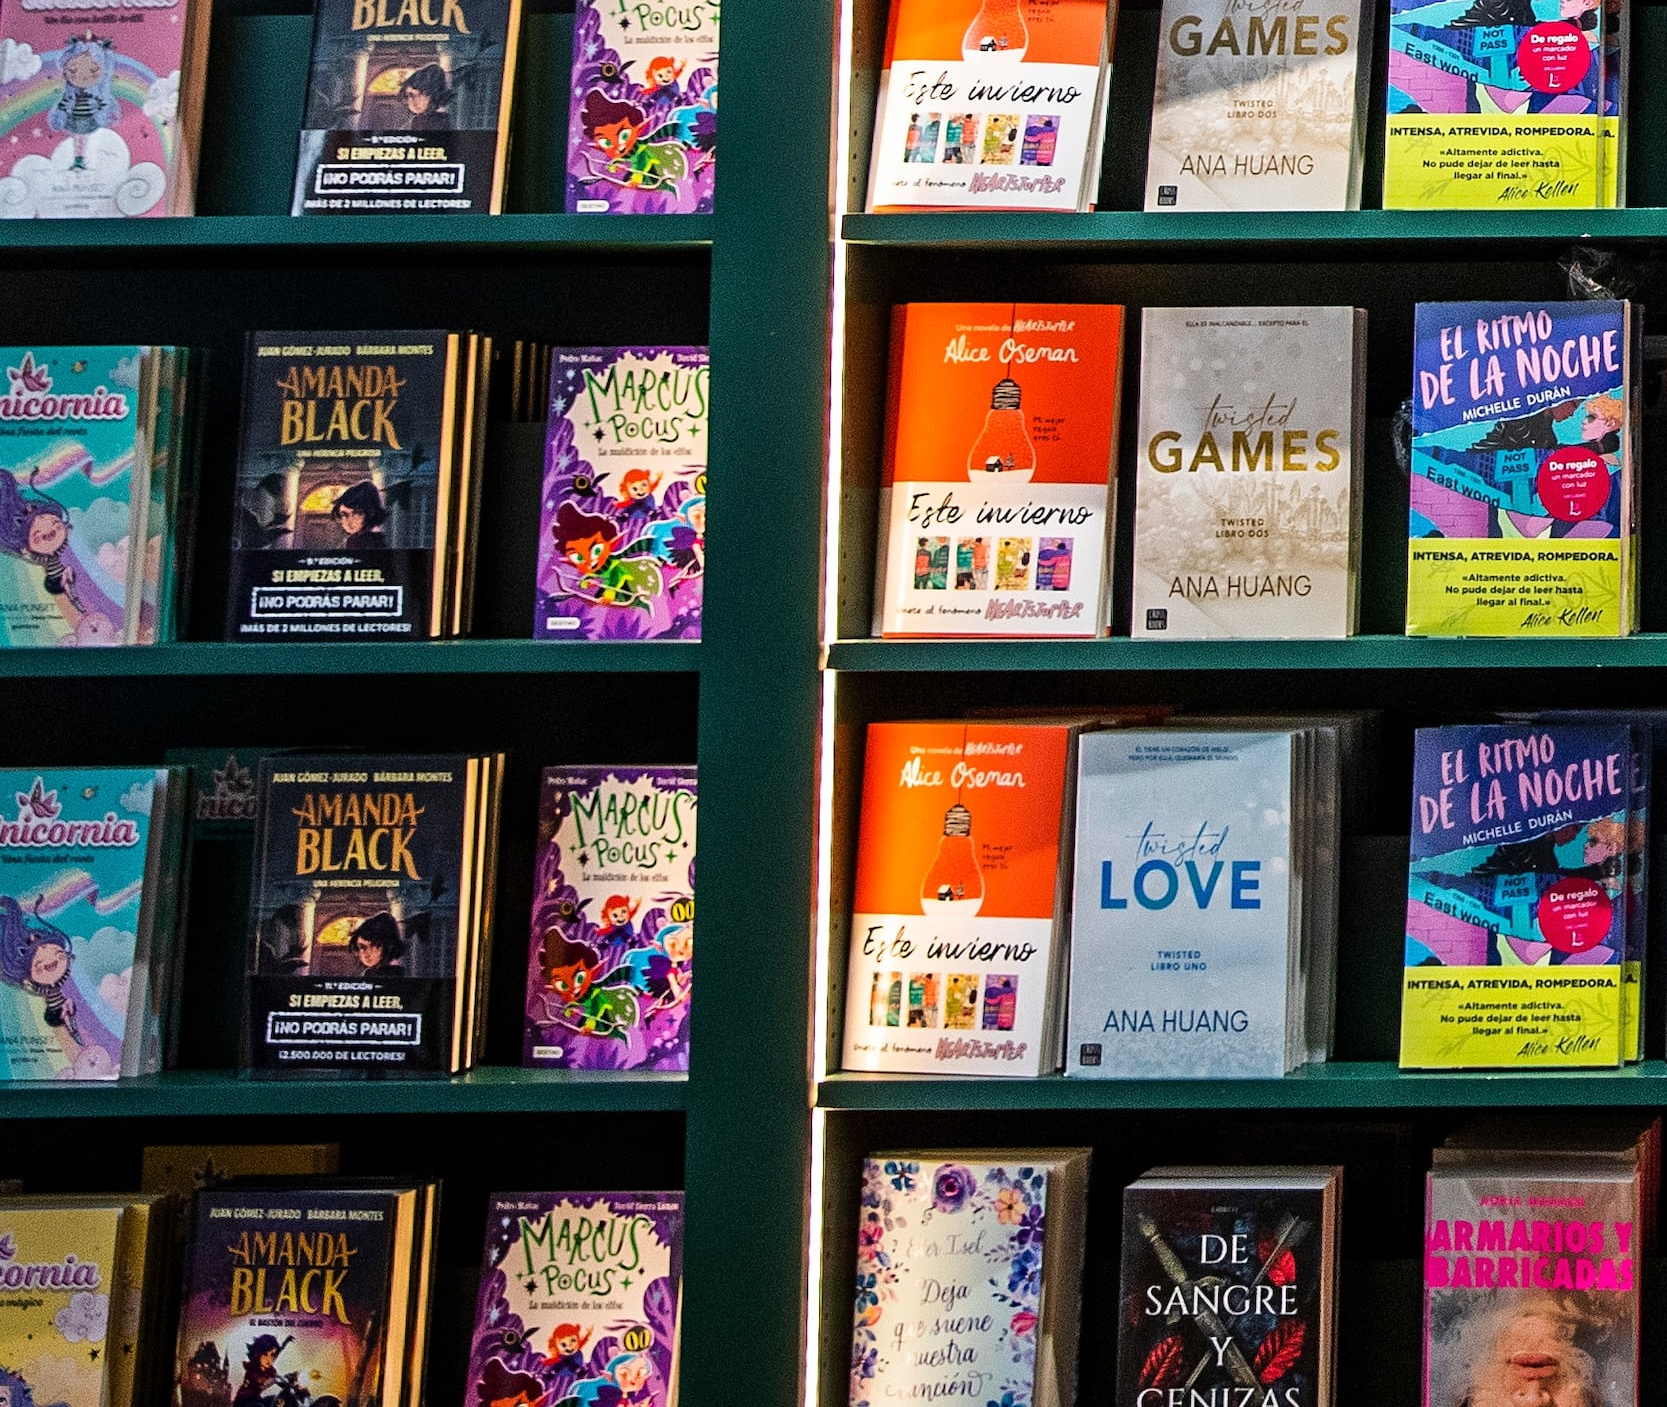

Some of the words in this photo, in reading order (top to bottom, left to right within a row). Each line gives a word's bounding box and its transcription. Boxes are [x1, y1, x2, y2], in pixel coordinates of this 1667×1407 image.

[944, 338, 994, 365] Alice
[999, 337, 1078, 363] Oseman
[277, 365, 407, 403] AMANDA
[280, 400, 403, 450] BLACK
[908, 492, 963, 527] Este
[975, 497, 1093, 527] invierno
[1100, 859, 1261, 911] LOVE
[520, 1215, 650, 1266] MARCUS
[1199, 1235, 1248, 1263] DE
[545, 1268, 619, 1296] POCUS
[1145, 1285, 1297, 1316] SANGRE
